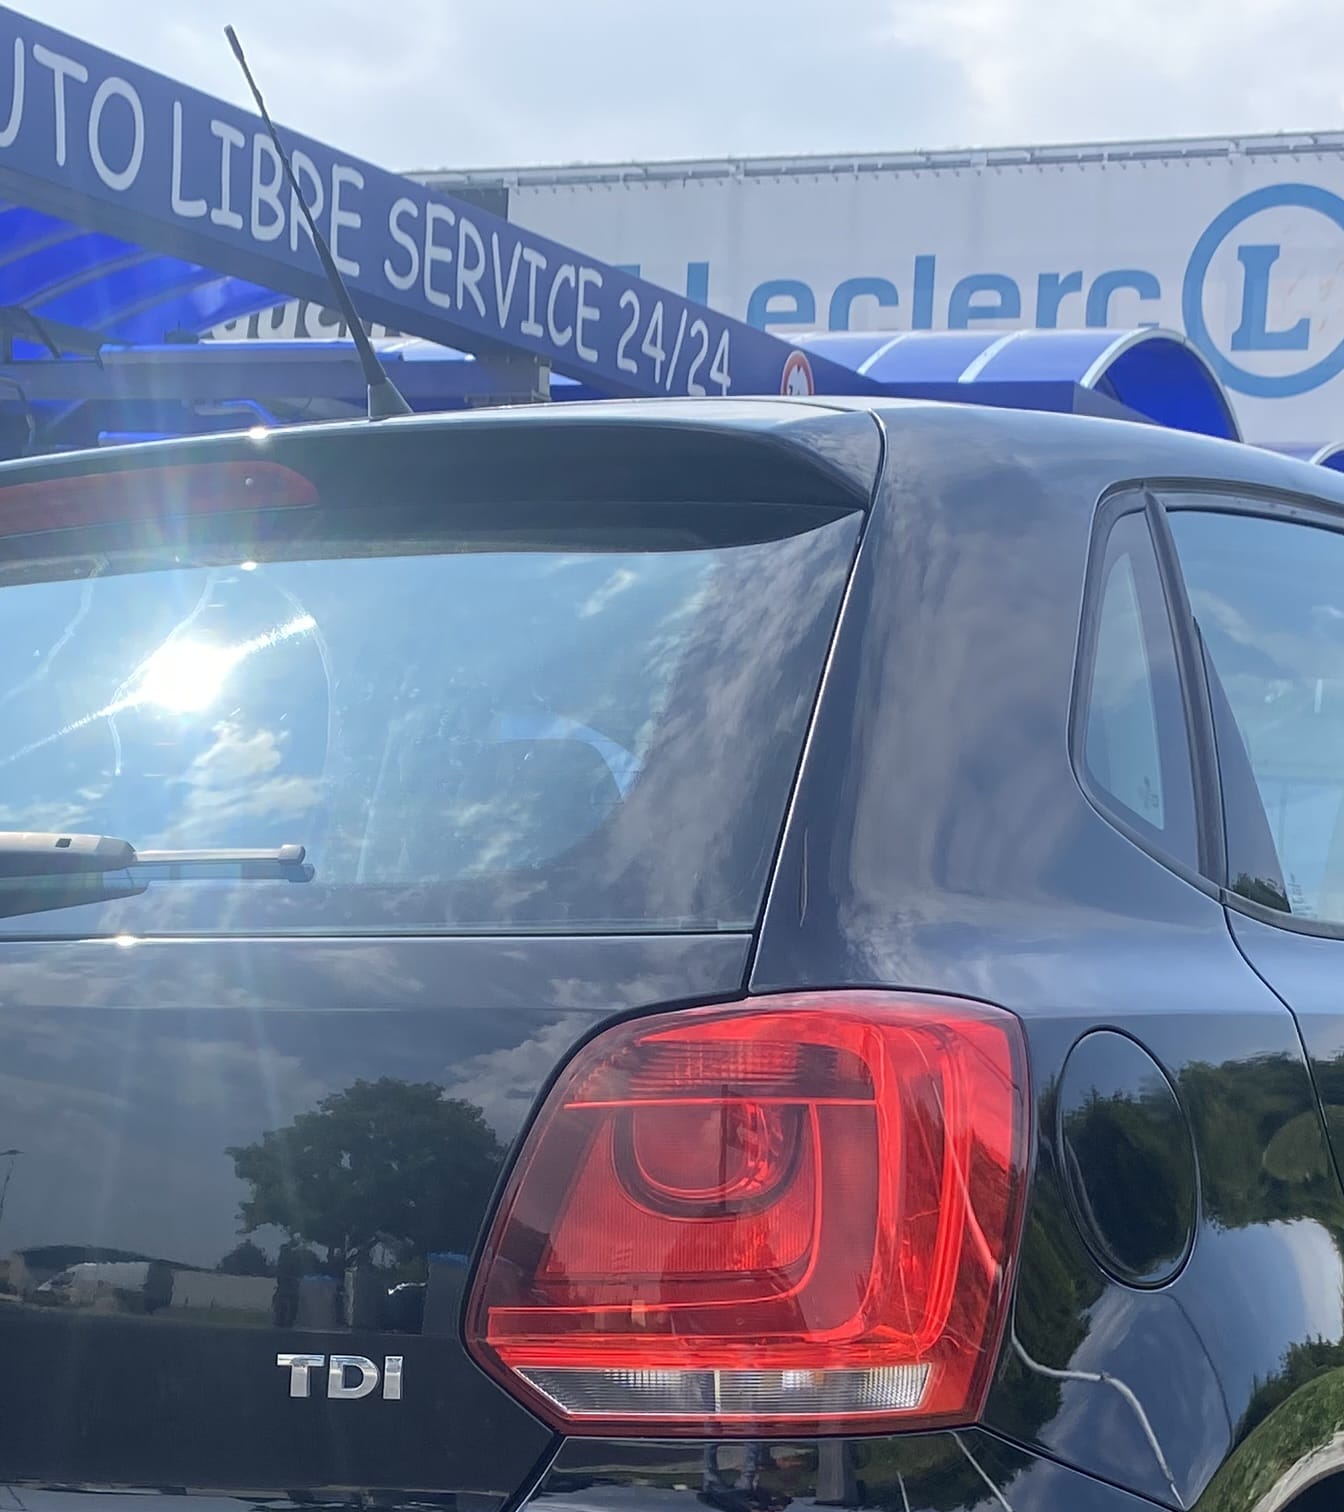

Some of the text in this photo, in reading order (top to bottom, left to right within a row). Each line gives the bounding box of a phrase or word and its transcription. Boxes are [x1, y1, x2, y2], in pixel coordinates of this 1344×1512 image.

[171, 100, 364, 277] LIBRE
[384, 198, 602, 363] SERVICE
[617, 289, 731, 396] 24/24
[1230, 244, 1312, 351] L
[277, 1354, 403, 1400] TDI
